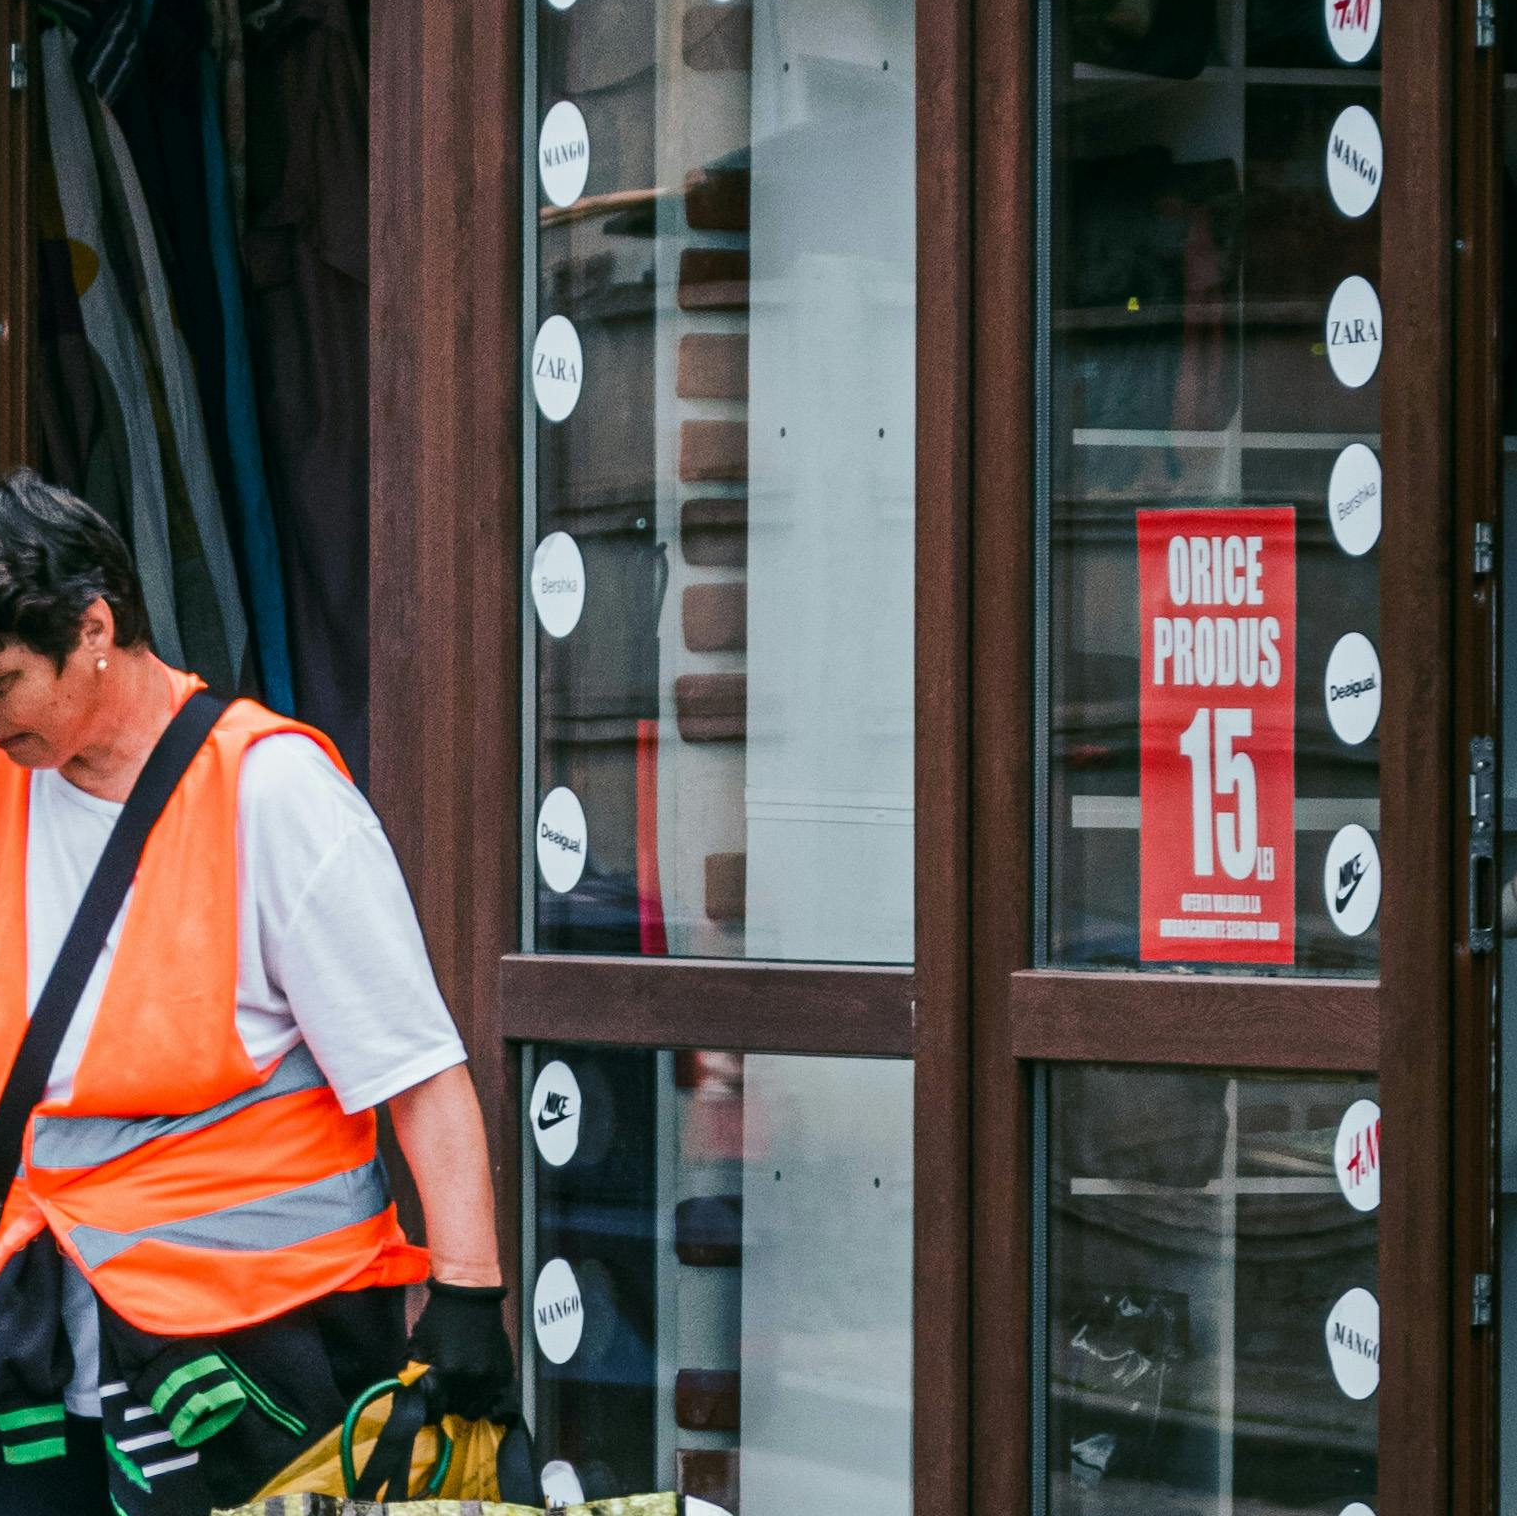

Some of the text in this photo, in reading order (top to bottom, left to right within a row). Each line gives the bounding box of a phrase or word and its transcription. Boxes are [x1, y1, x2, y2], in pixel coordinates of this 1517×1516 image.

[543, 139, 586, 170] MANGO
[1331, 135, 1379, 186] MANGO
[1330, 318, 1379, 346] ZARA
[536, 352, 578, 384] ZARA
[1337, 482, 1378, 522] Bershka
[1168, 535, 1264, 606] ORICE
[1153, 616, 1281, 688] PRODUS
[1179, 707, 1258, 880] 15
[544, 1090, 571, 1118] NIKE
[538, 1294, 579, 1328] MANGO
[1333, 1322, 1380, 1365] MANGO
